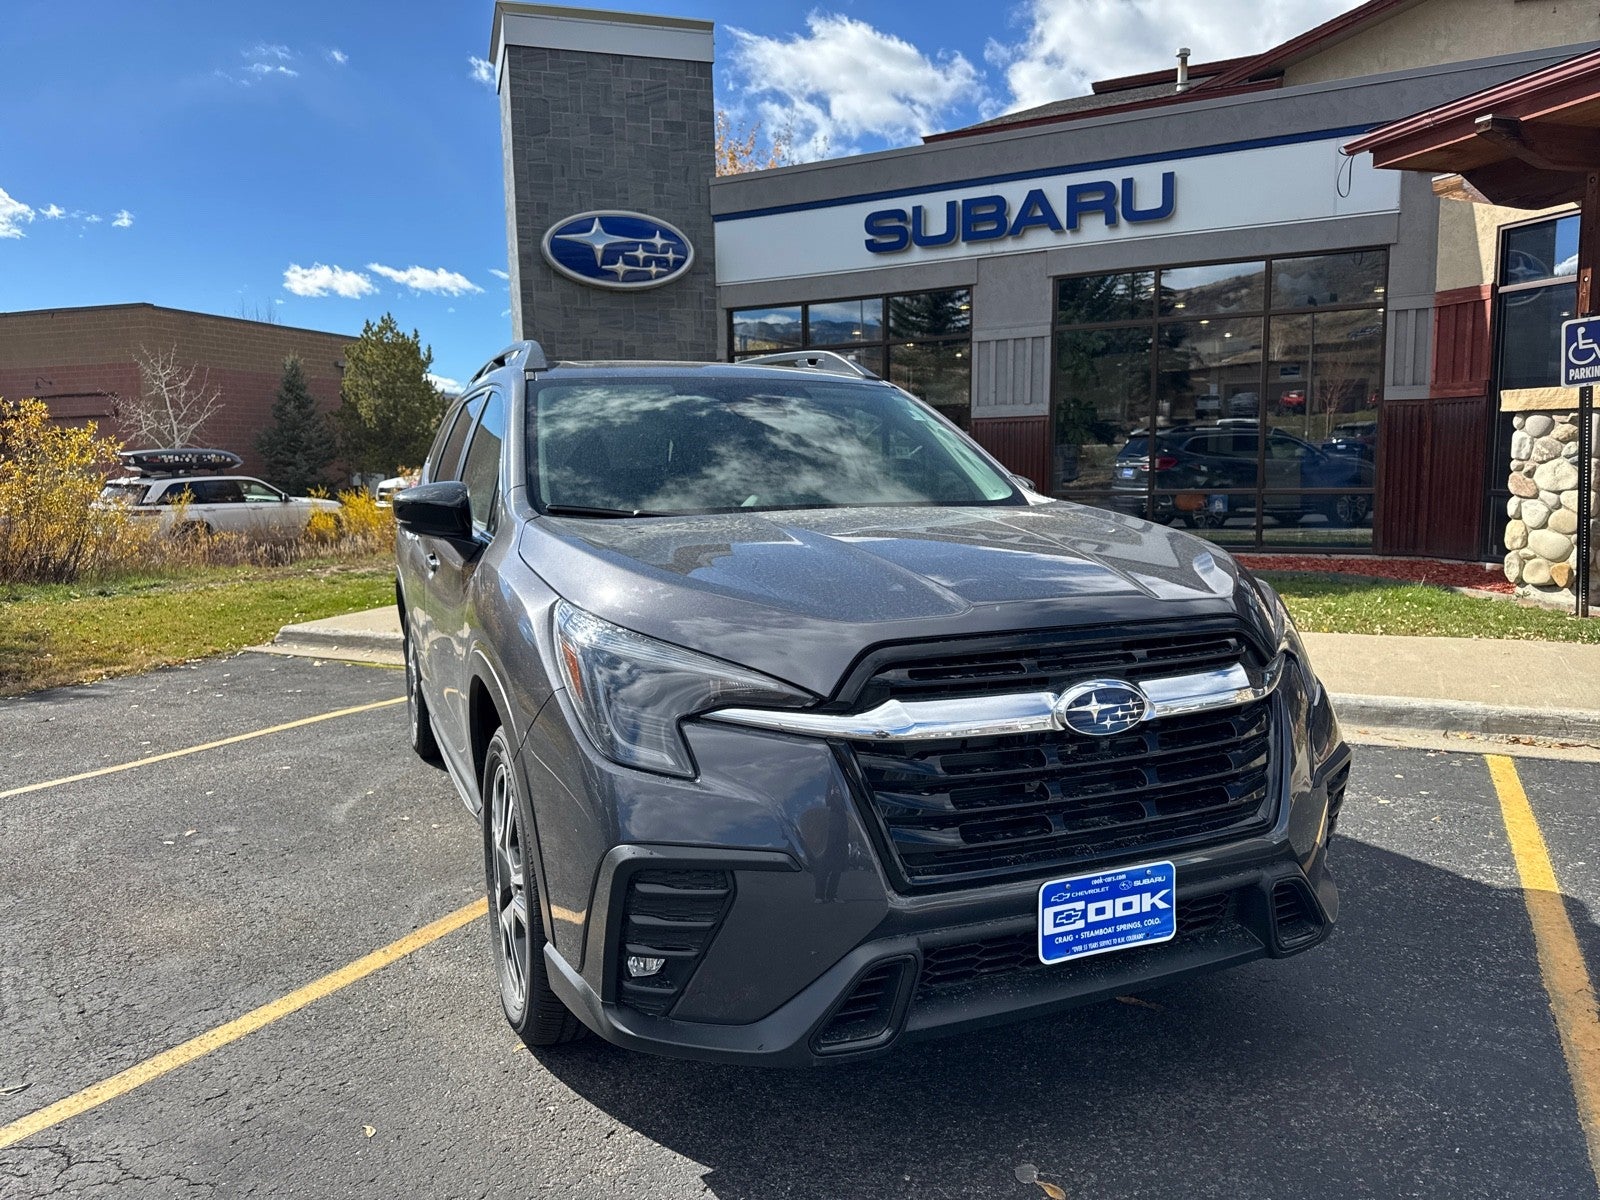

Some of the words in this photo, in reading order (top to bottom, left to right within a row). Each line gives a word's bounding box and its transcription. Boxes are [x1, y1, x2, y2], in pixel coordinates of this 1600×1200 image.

[864, 171, 1175, 253] SUBARU
[1091, 874, 1127, 886] cook-cars.com
[1133, 876, 1166, 887] SUBARU
[1071, 886, 1110, 898] CHEVROLET
[1044, 889, 1171, 936] COOK
[1055, 934, 1074, 944] CRAIG
[1080, 926, 1116, 939] STEAMBOAT
[1143, 917, 1161, 927] COLO.
